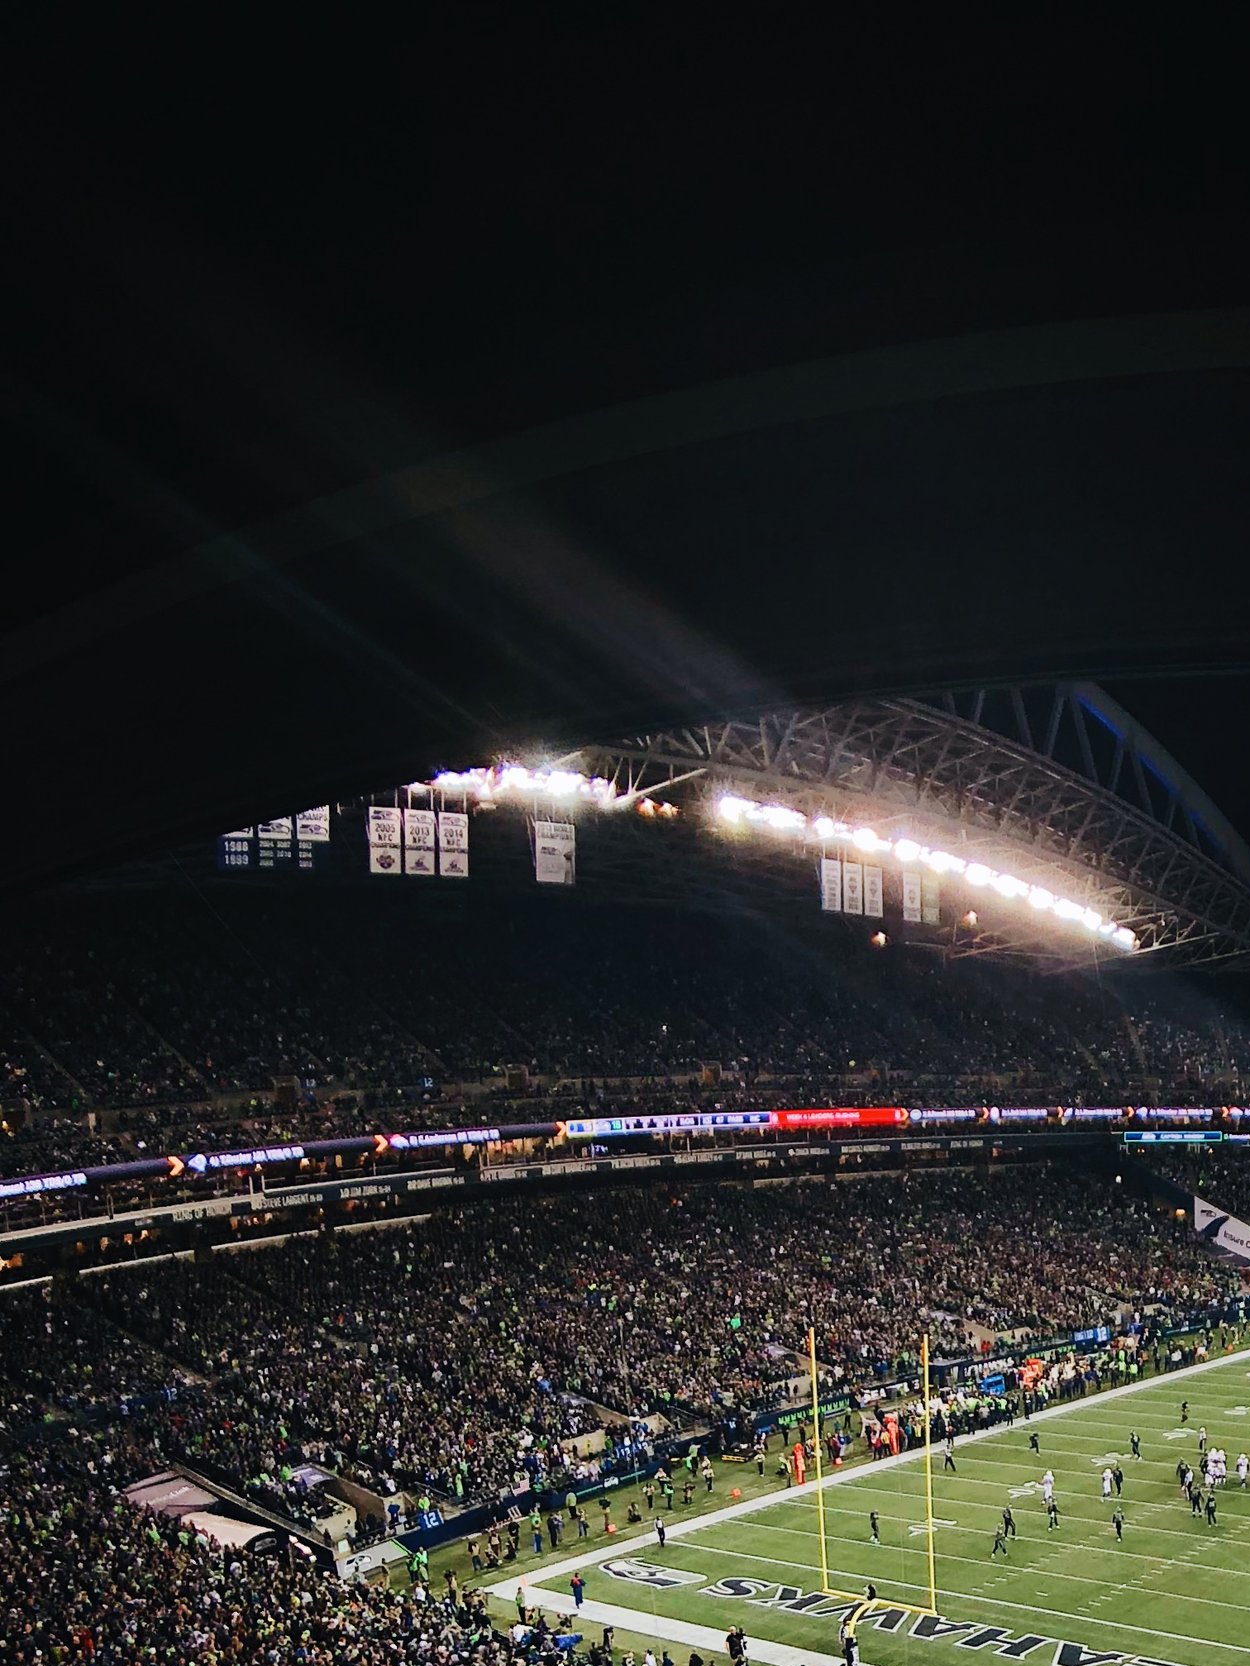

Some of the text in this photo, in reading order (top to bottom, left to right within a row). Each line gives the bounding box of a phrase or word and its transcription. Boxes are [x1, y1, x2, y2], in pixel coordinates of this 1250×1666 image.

[263, 1197, 282, 1210] STEVE
[283, 1193, 308, 1208] LARGENT
[172, 1207, 194, 1223] RING
[195, 1206, 205, 1219] OF
[1224, 1230, 1245, 1247] Insure
